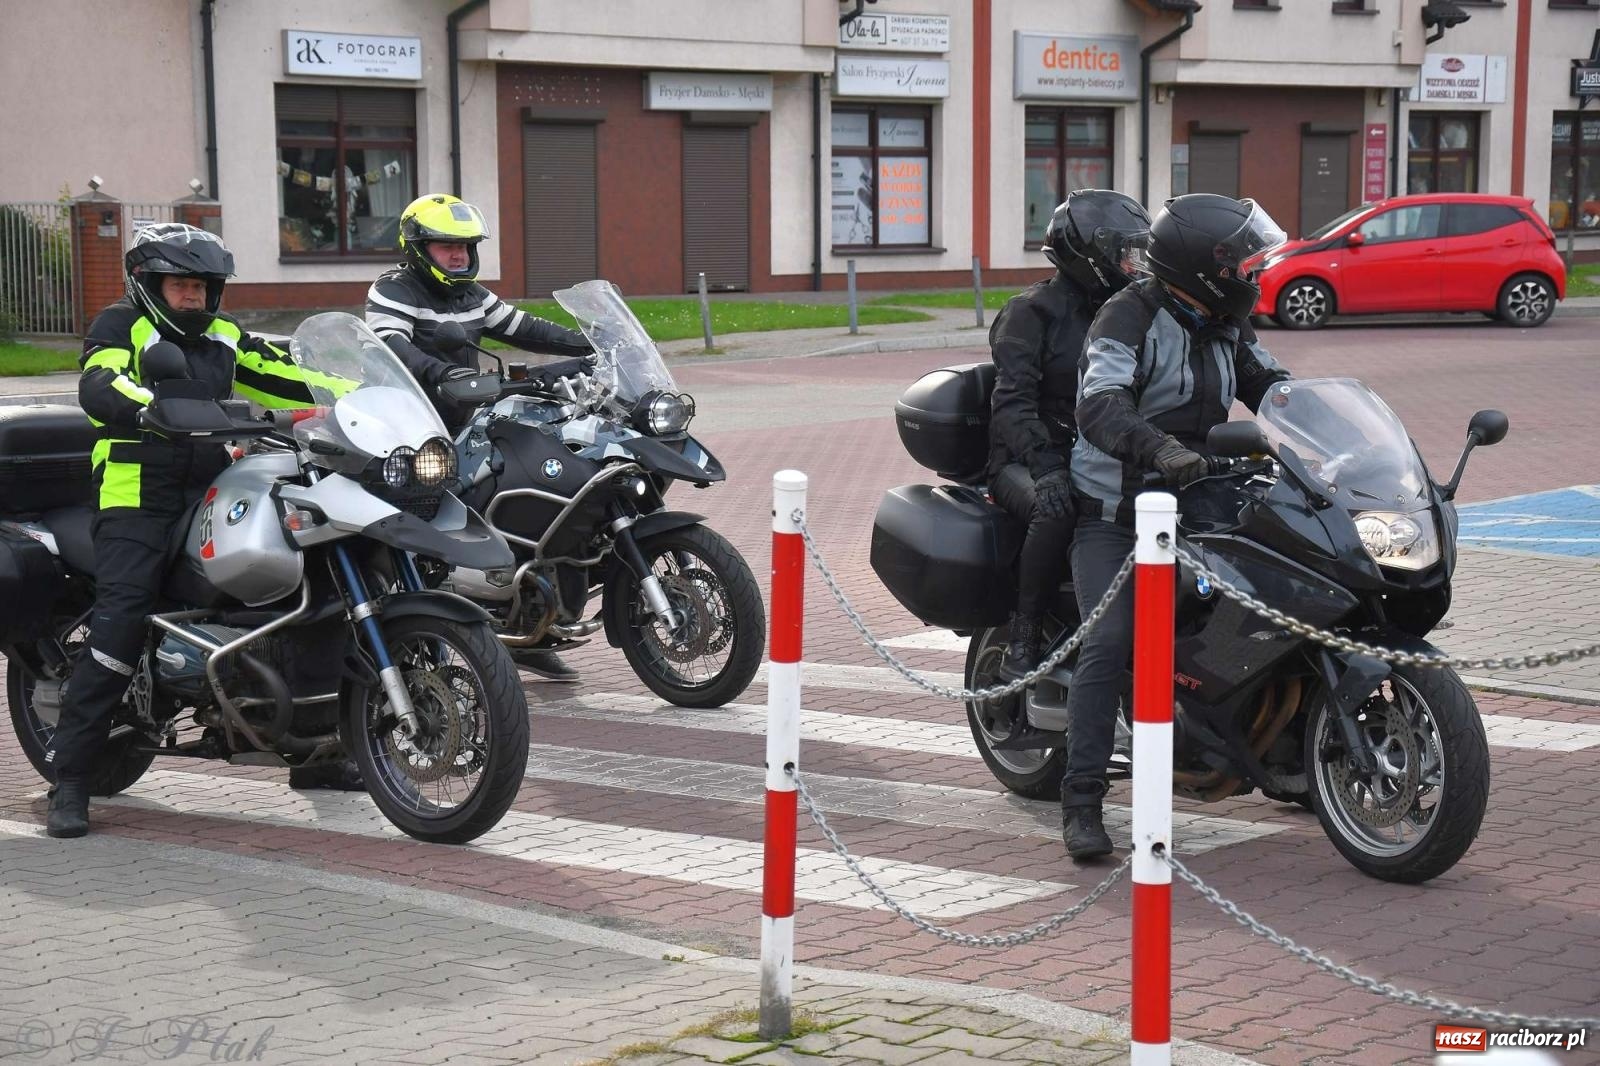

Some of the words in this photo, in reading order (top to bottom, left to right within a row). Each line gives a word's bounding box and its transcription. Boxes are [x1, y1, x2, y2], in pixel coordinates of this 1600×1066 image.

[846, 19, 881, 38] Ola-la
[337, 42, 416, 57] FOTOGRAF
[1043, 40, 1120, 71] dentica
[841, 64, 864, 77] Salon
[659, 84, 691, 99] Fryzjer
[738, 86, 765, 102] Męski
